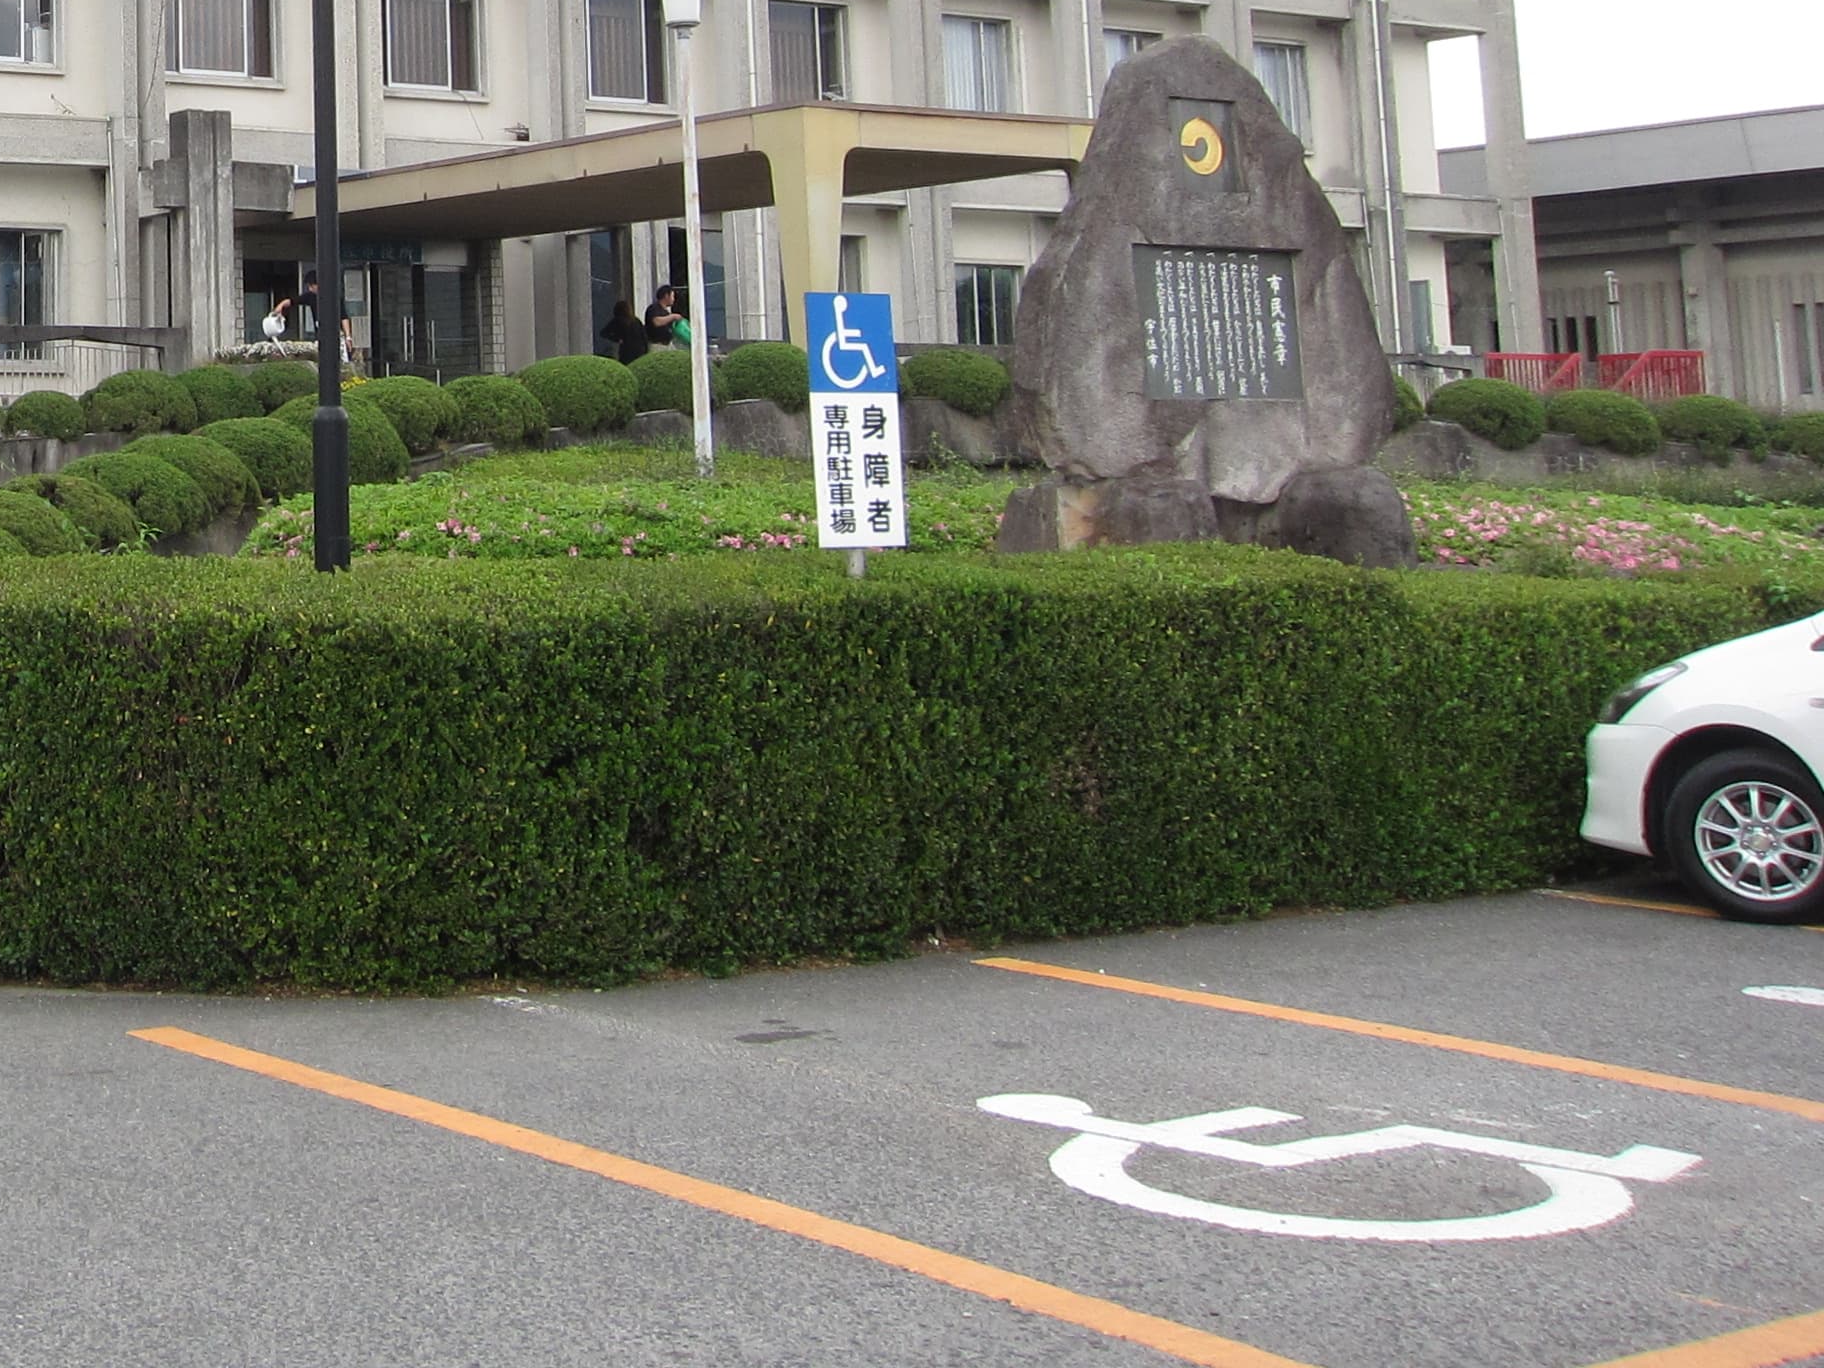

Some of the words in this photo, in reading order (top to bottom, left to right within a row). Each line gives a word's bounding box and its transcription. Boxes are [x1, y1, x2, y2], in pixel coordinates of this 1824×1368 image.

[823, 404, 857, 534] 専用駐車場
[861, 403, 892, 534] 身障者
